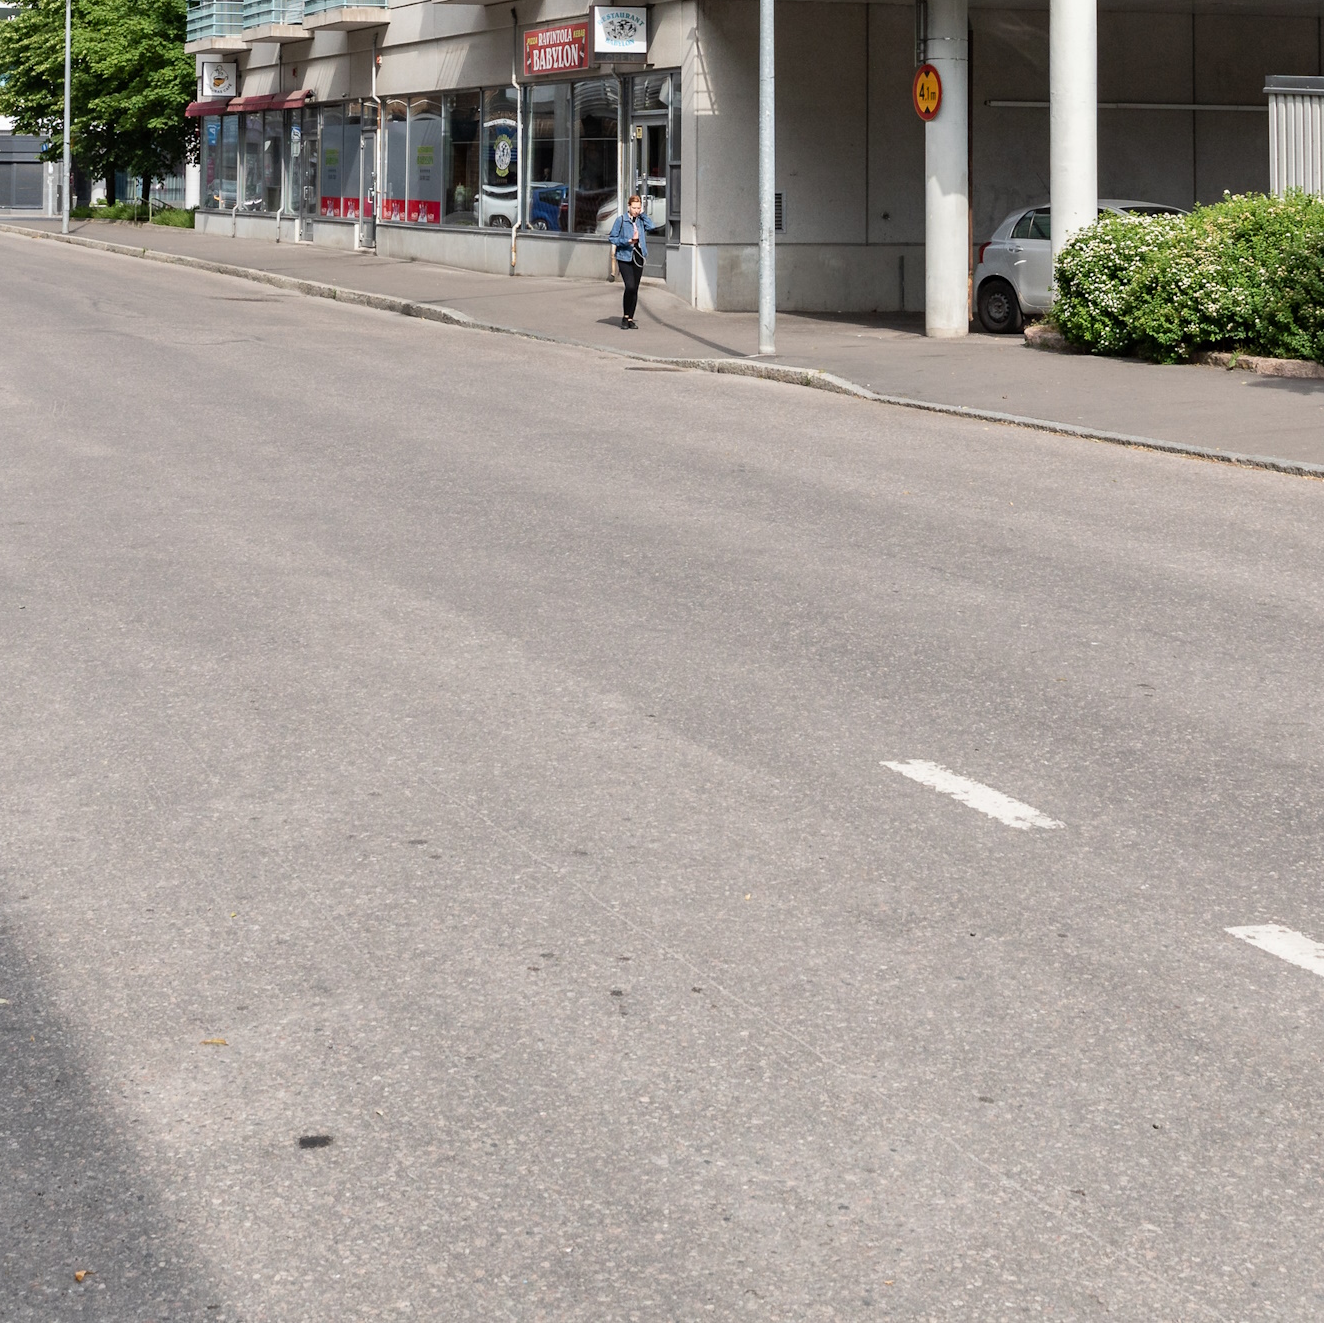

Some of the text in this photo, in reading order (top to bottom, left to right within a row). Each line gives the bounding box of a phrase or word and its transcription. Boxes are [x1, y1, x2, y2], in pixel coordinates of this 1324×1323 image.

[597, 12, 645, 27] RESTAURANT
[526, 28, 586, 46] PIZZA RAVINTOLA KEBAB
[532, 44, 579, 71] BABYLON
